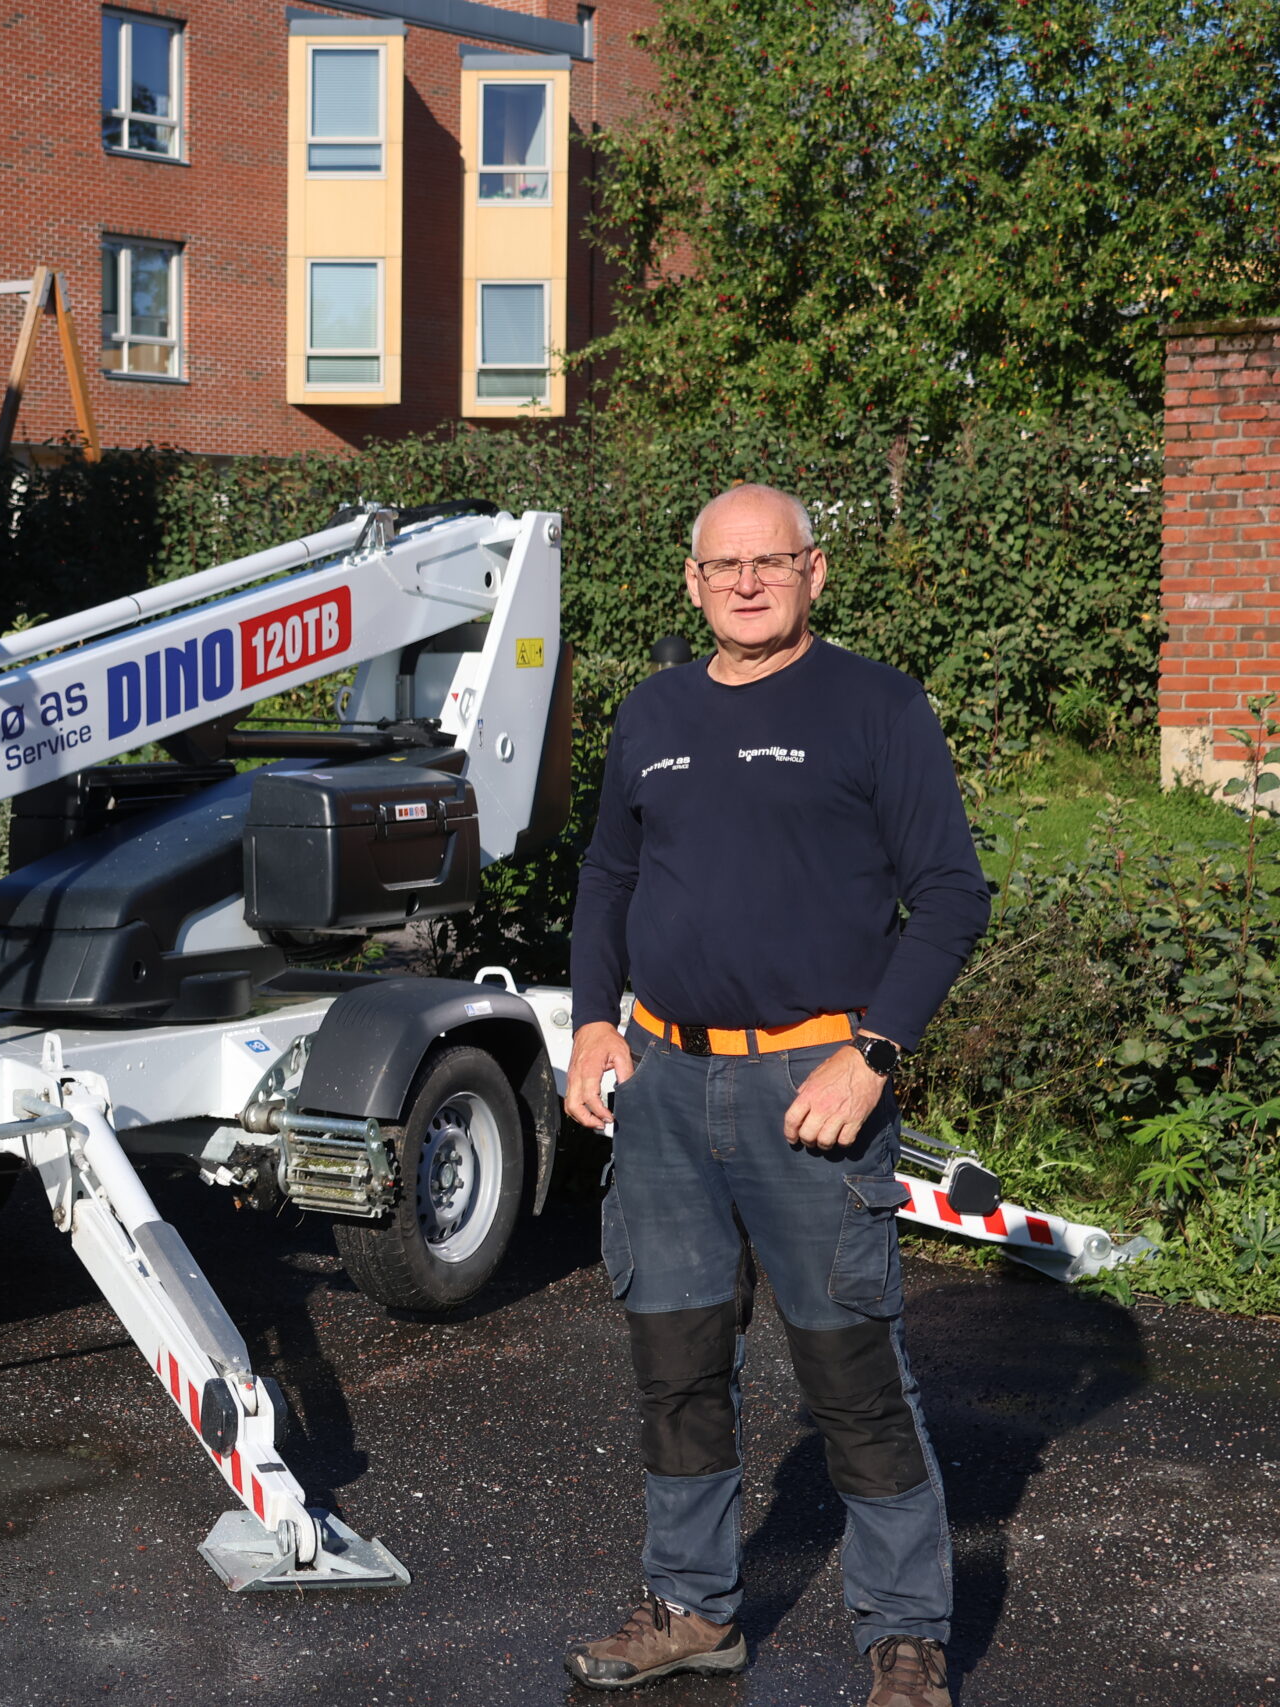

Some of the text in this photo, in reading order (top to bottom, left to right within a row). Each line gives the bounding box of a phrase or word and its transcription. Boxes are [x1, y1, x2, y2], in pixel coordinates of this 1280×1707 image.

[251, 601, 341, 676] 120TB
[40, 682, 88, 727] as
[107, 628, 234, 741] DINO
[5, 724, 92, 771] Service
[676, 756, 690, 764] as
[790, 750, 806, 758] as
